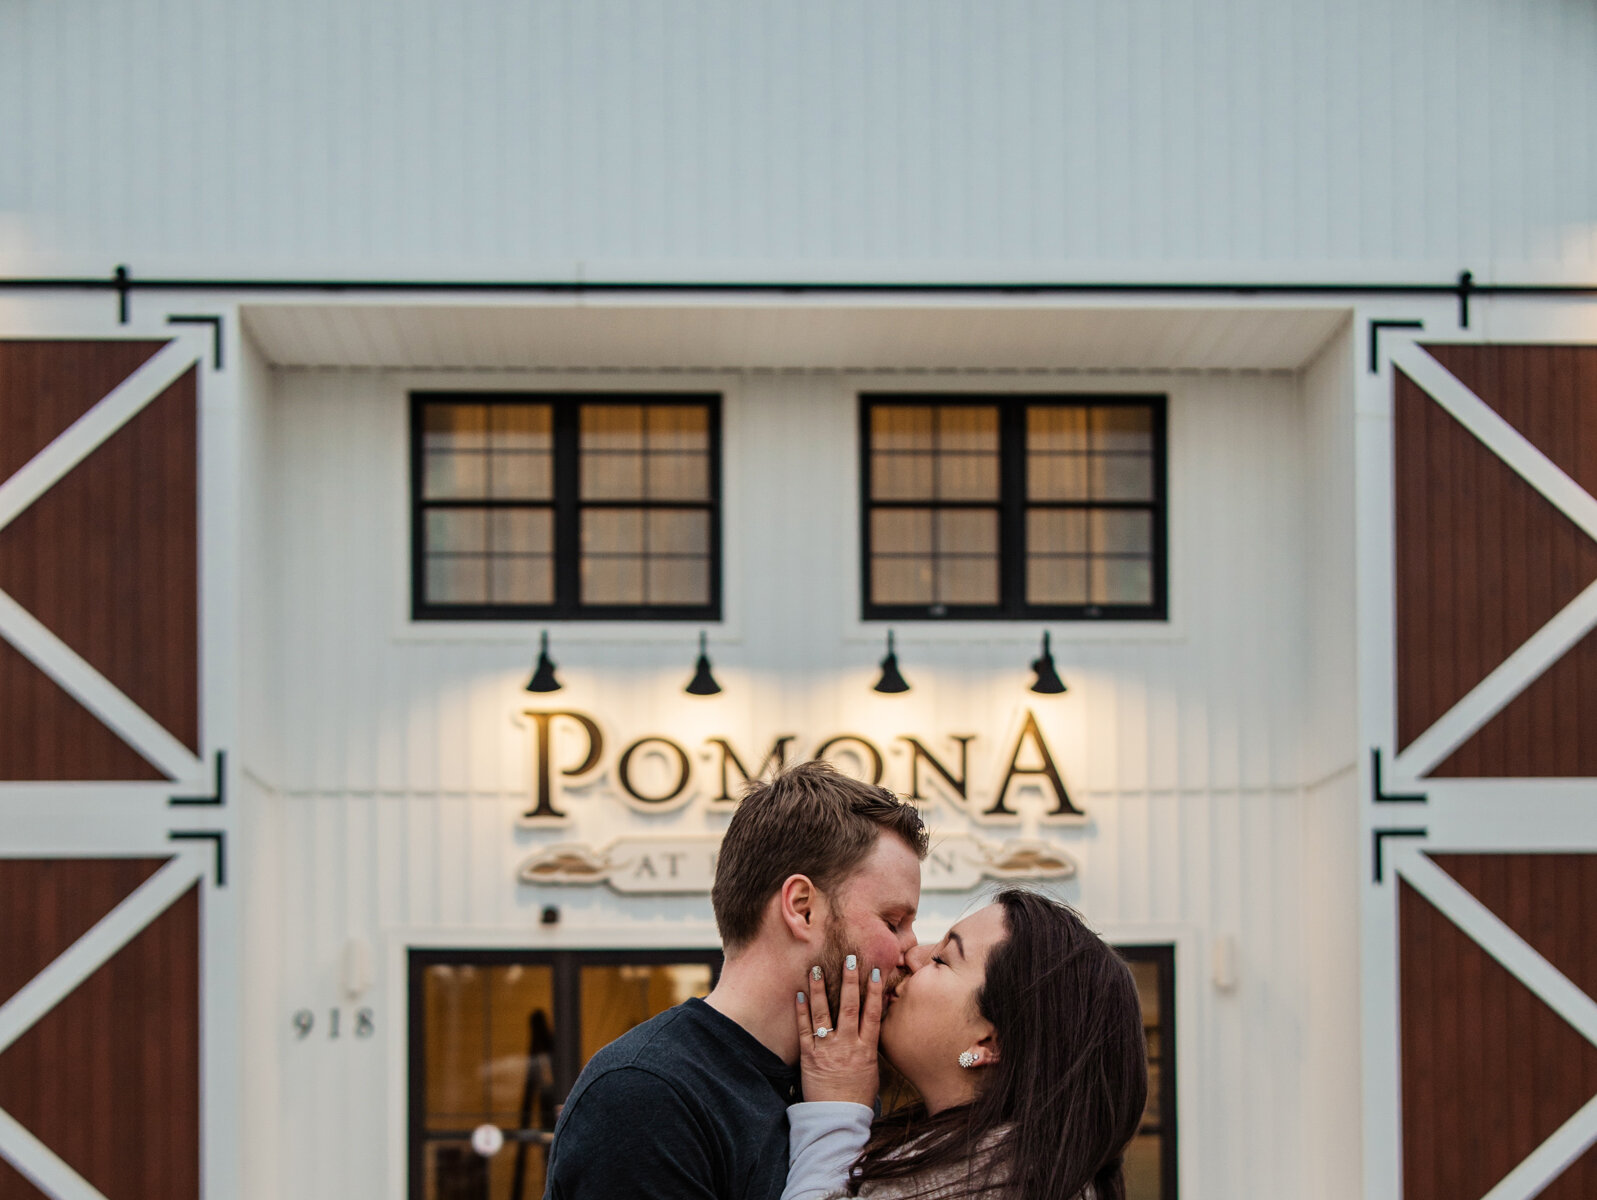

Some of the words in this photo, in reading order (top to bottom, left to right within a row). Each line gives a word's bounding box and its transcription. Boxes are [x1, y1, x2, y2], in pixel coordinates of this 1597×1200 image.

[523, 708, 1085, 817] POMONA
[633, 852, 687, 878] AT
[292, 1007, 375, 1040] 918
